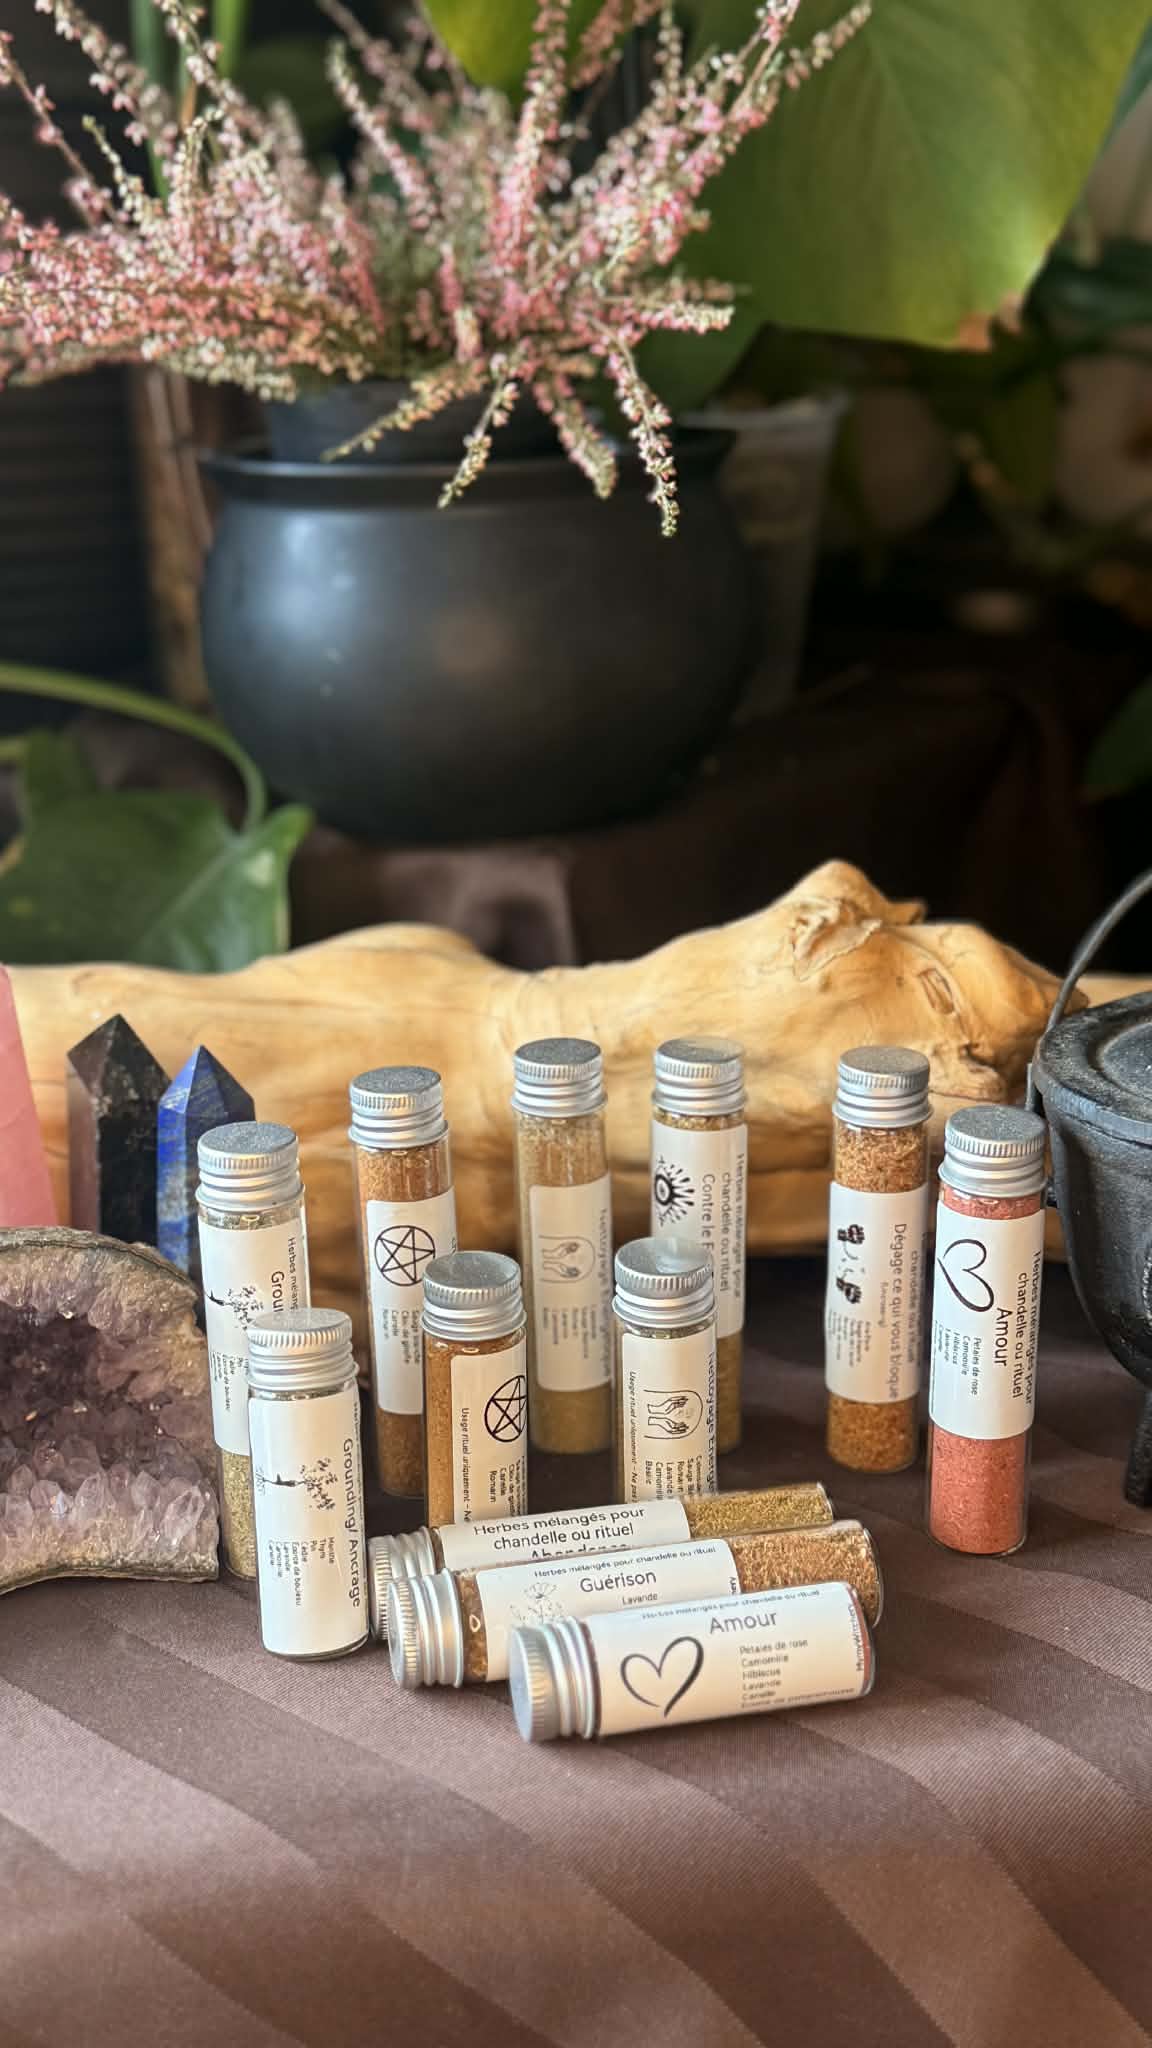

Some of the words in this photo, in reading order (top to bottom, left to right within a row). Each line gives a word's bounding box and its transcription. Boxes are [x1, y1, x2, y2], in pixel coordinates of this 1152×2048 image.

[701, 1174, 715, 1221] Contre
[721, 1172, 734, 1233] chandelle
[701, 1226, 716, 1237] le
[720, 1238, 730, 1254] ou
[890, 1224, 907, 1275] Dégage
[719, 1257, 732, 1292] rituel
[892, 1278, 903, 1293] ce
[889, 1297, 904, 1317] qui
[1016, 1272, 1030, 1338] chandelle
[890, 1322, 901, 1350] vous
[994, 1306, 1014, 1367] Amour
[1013, 1342, 1025, 1359] ou
[887, 1354, 903, 1398] bloque
[1011, 1363, 1026, 1399] rituel
[344, 1438, 358, 1533] Grounding/
[474, 1518, 529, 1536] Herbes
[534, 1511, 607, 1530] mélangés
[611, 1507, 646, 1525] pour
[494, 1528, 568, 1551] chandelle
[571, 1530, 592, 1543] ou
[595, 1523, 635, 1540] rituel
[349, 1540, 361, 1607] Ancrage
[580, 1570, 657, 1592] Guérison
[622, 1592, 658, 1605] Lavande
[709, 1612, 778, 1635] Amour
